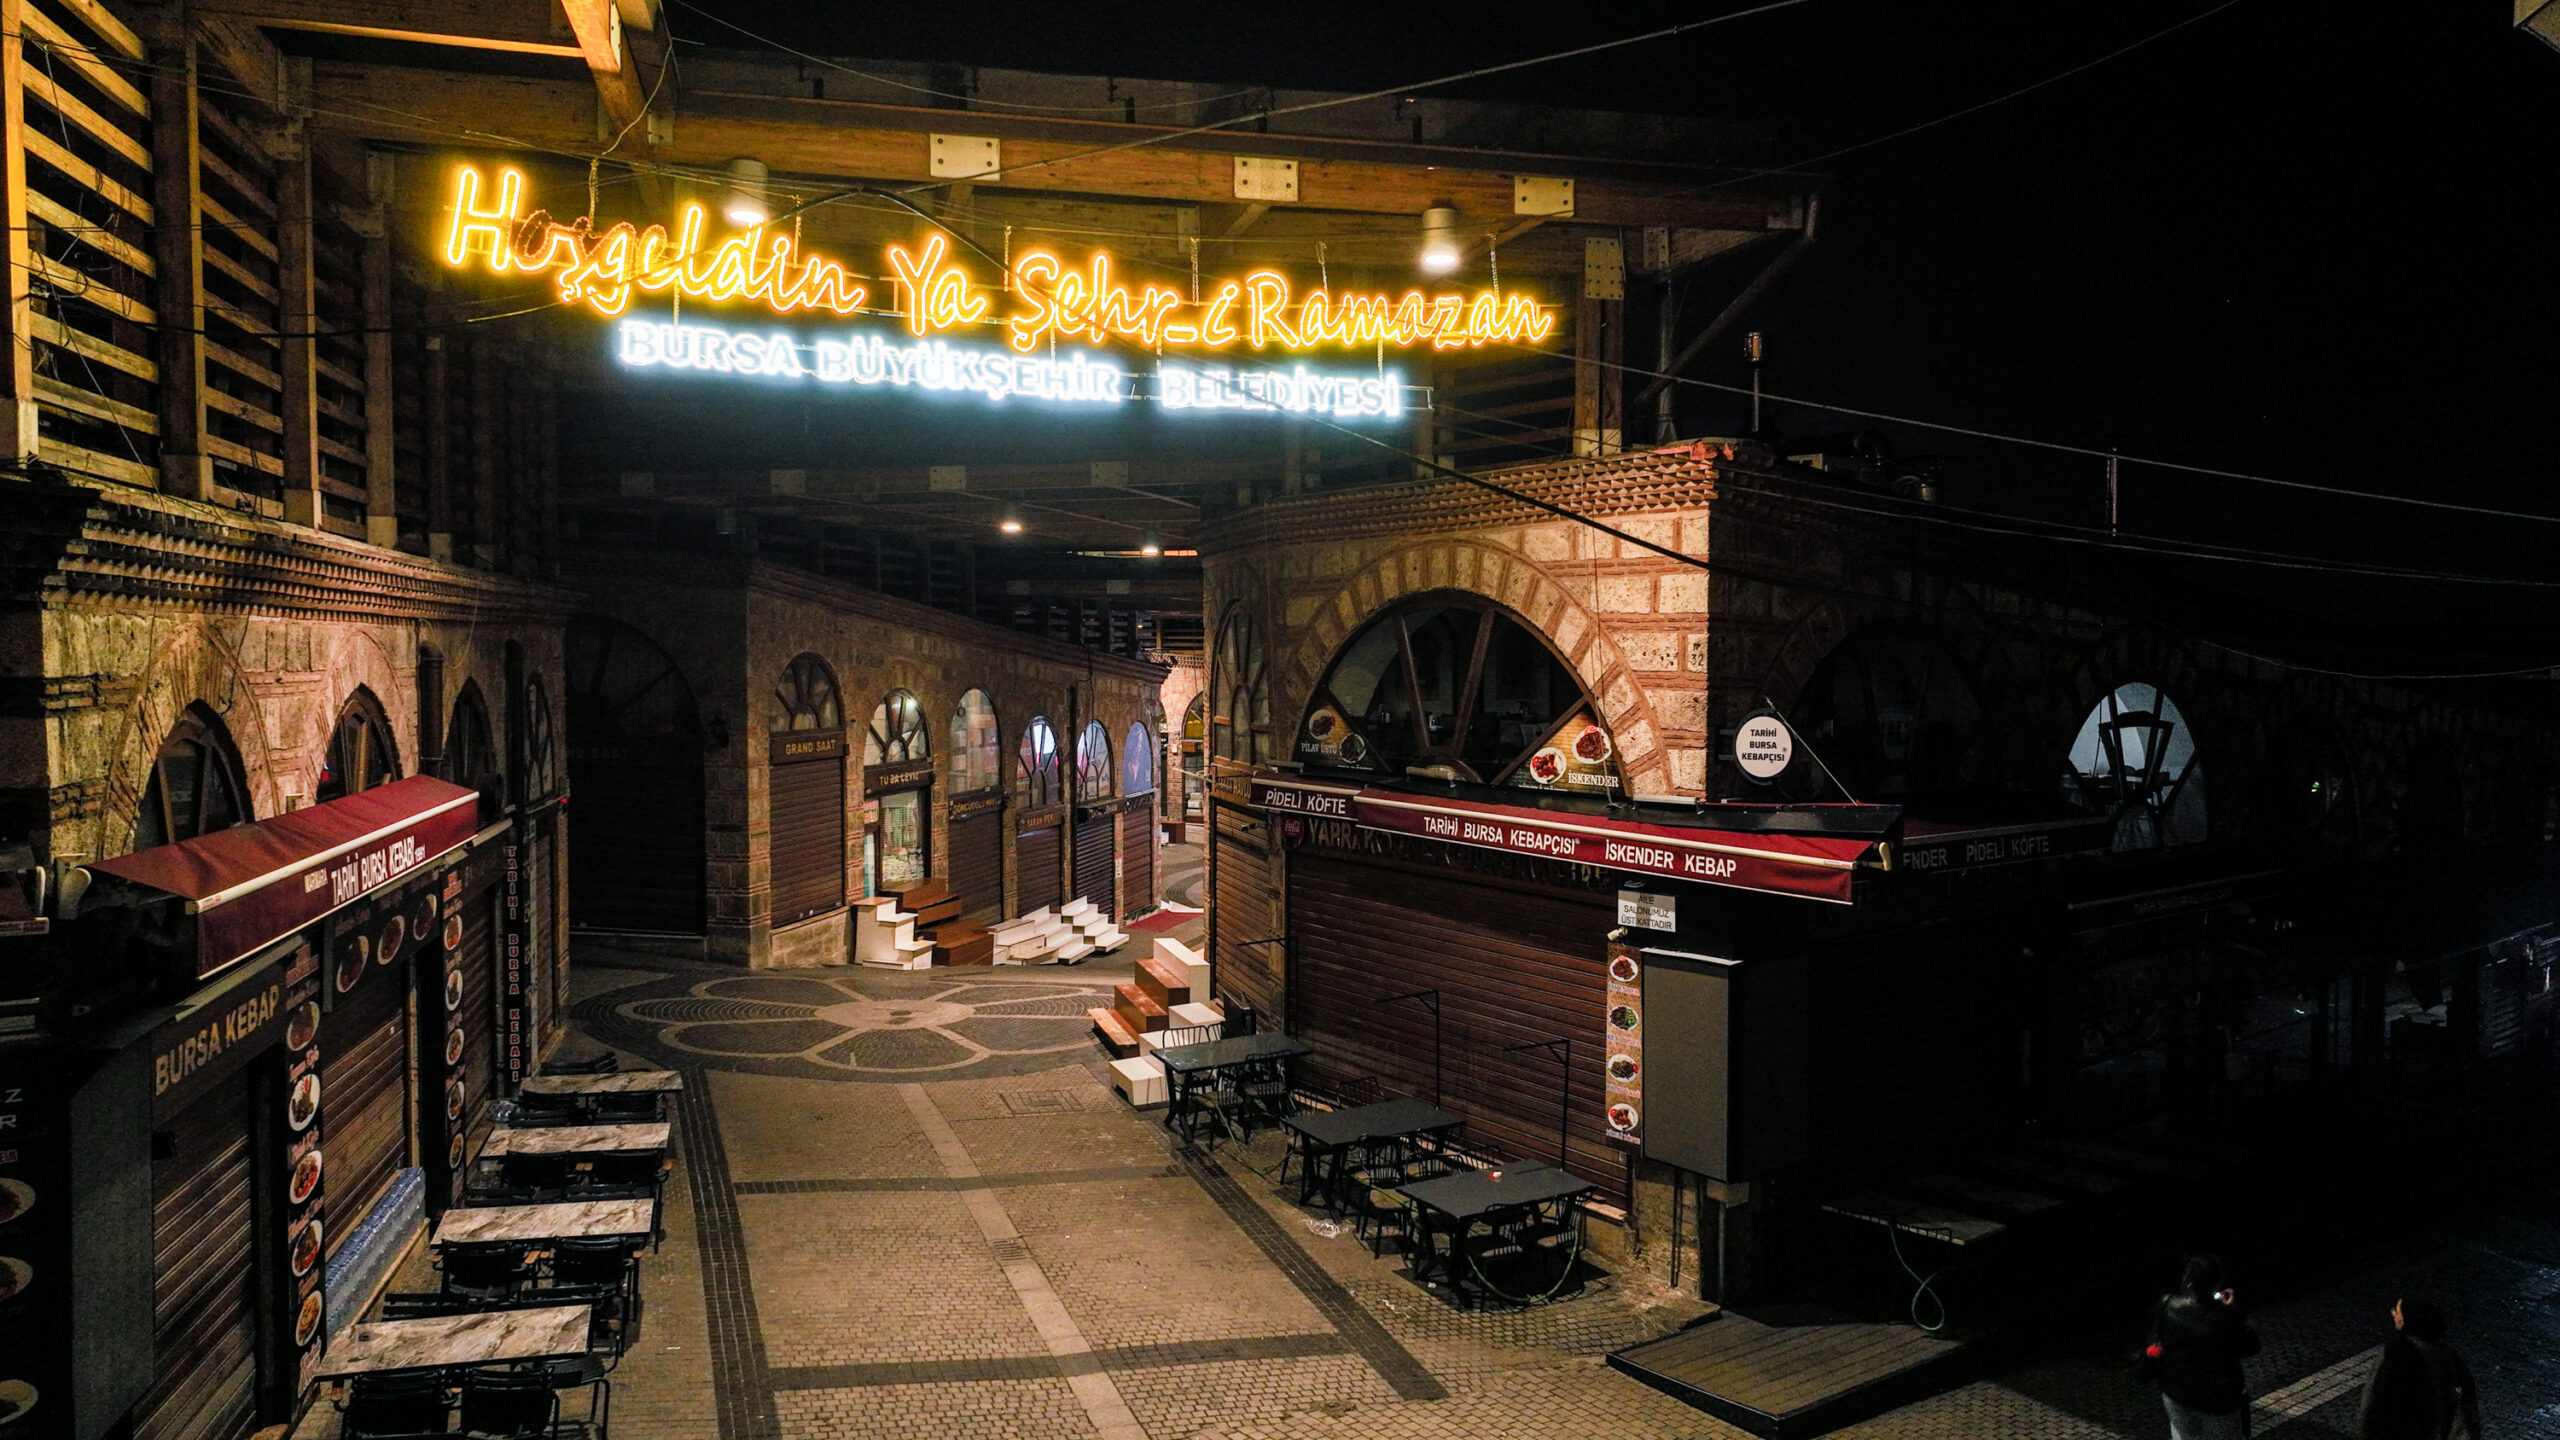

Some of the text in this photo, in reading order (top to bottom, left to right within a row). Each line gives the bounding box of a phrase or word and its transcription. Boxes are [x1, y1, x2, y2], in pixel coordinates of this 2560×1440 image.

[889, 235, 987, 337] Ya
[1246, 271, 1553, 350] Ramazan
[619, 320, 1402, 418] BURSA BÜYÜKŞEHİR BELEDİYESİ
[1691, 653, 1704, 666] 32
[1749, 741, 1777, 749] BURSA
[1750, 727, 1777, 737] TARİHİ
[785, 739, 837, 756] GRAND SAAT
[1742, 752, 1785, 764] KEBAPÇISI
[1567, 769, 1619, 788] İSKENDER
[1265, 787, 1347, 815] PİDELİ KÖFTE
[1423, 815, 1459, 837] TARİHİ
[1463, 822, 1504, 844] BURSA
[330, 852, 360, 906] TARİHİ
[360, 848, 389, 892] BURSA
[388, 835, 415, 876] KEBABI
[1605, 838, 1737, 878] İSKENDER KEBAP
[1623, 904, 1669, 918] SALONUMUZ
[1636, 916, 1672, 930] KATTADIR
[508, 932, 520, 996] BURSA
[155, 1021, 223, 1097] BURSA
[224, 984, 280, 1049] KEBAP
[509, 1007, 521, 1083] KEBABI
